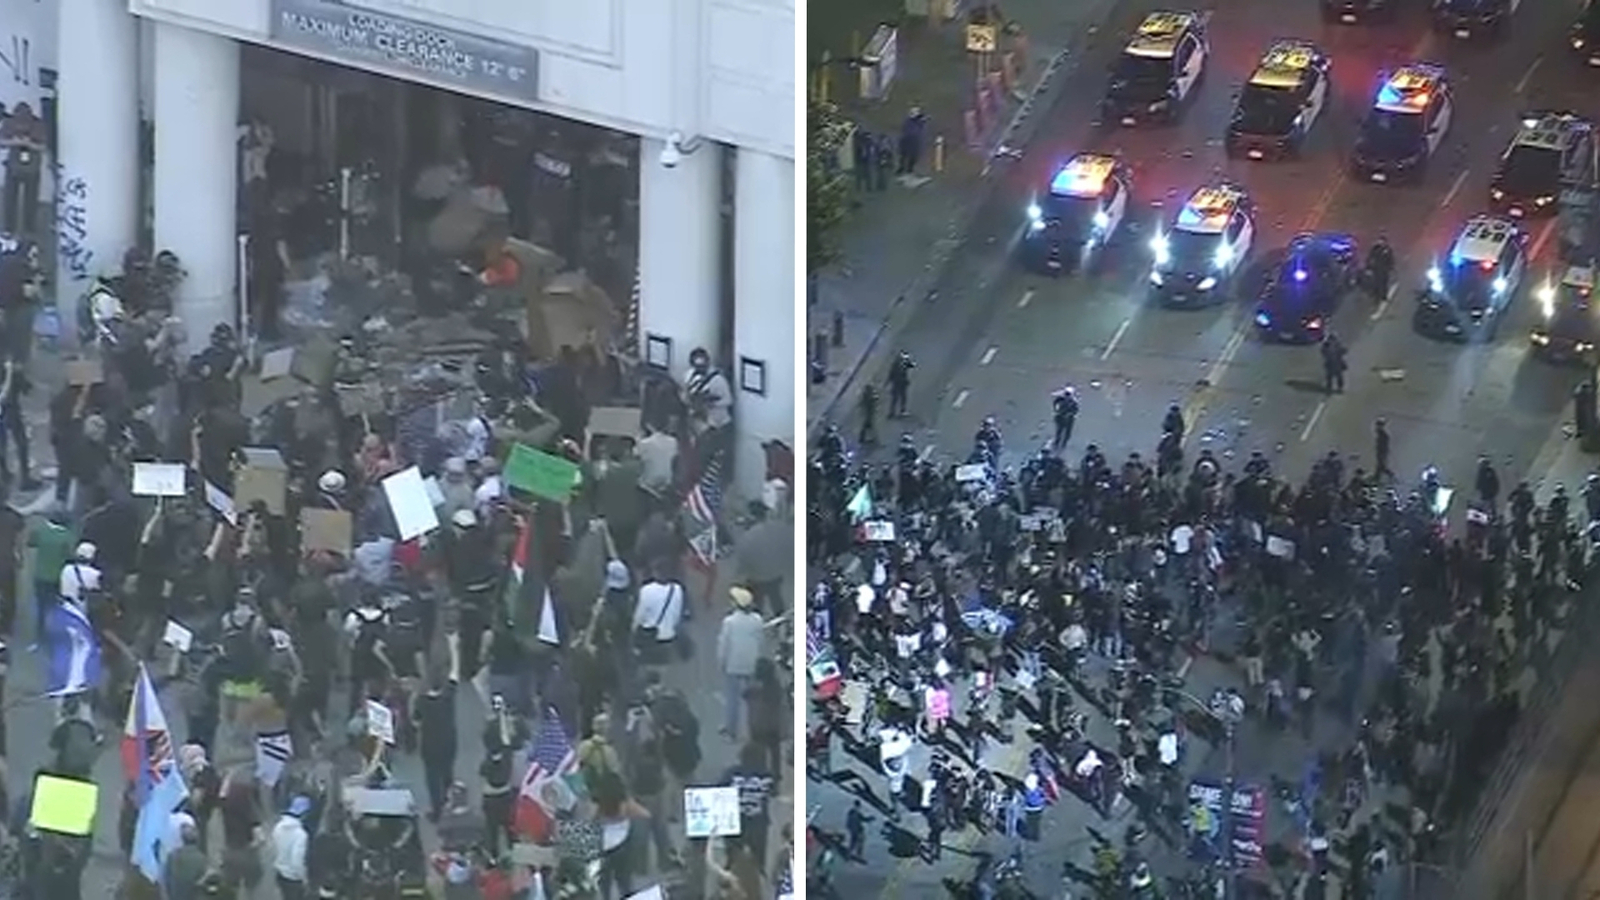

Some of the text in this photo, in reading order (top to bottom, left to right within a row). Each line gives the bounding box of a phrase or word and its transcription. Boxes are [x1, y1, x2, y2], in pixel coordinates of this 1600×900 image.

[281, 11, 368, 45] MAXIMUM
[375, 34, 474, 68] CLEARANCE
[348, 14, 456, 50] LOADING DOCK
